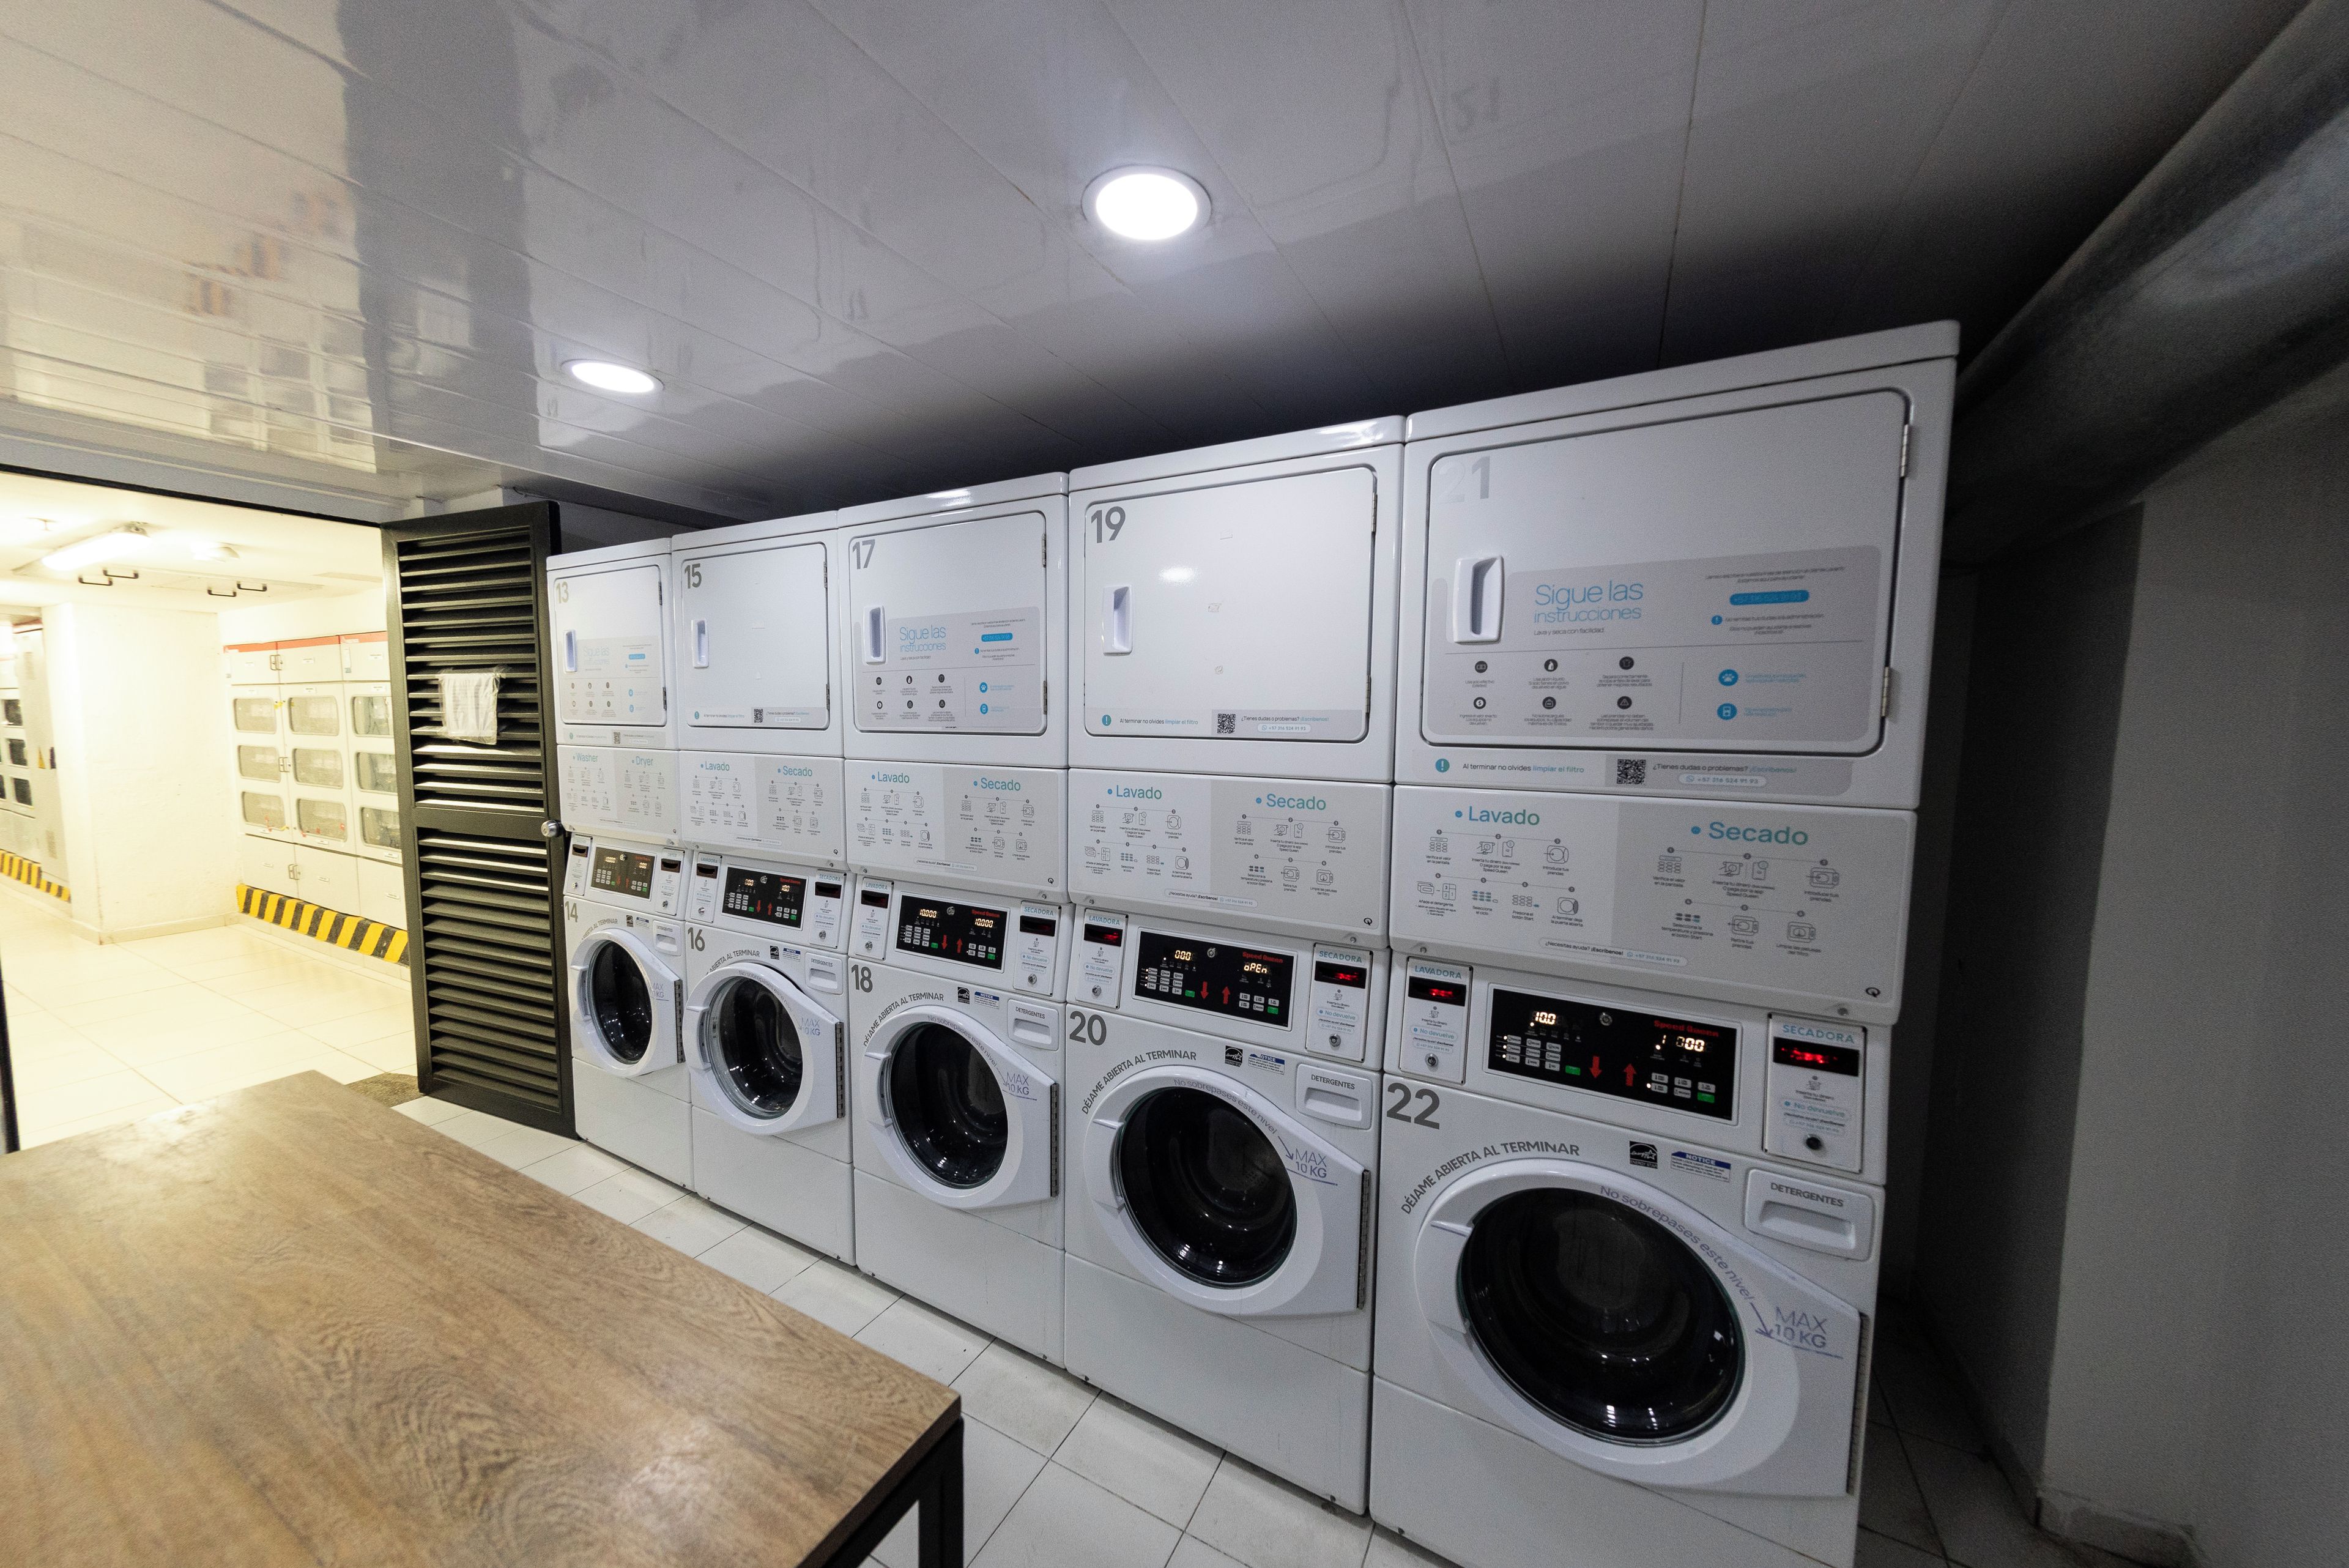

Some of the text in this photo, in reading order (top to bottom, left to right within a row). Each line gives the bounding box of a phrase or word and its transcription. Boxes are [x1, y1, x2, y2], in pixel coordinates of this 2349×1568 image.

[1438, 456, 1491, 503] 21
[1091, 506, 1126, 543] 19
[852, 538, 875, 570] 17
[684, 563, 702, 589] 15
[555, 581, 569, 603] 13
[1535, 580, 1644, 611] Sigue las
[1534, 607, 1642, 623] instrucciones
[899, 625, 946, 644] Sigue las
[900, 642, 946, 653] instrucciones
[576, 752, 598, 762] Washer
[636, 756, 653, 768] Dryer
[705, 761, 730, 771] Lavado
[782, 765, 813, 776] Secado
[877, 771, 910, 784] Lavado
[981, 778, 1021, 791] Secado
[1116, 784, 1162, 800] Lavado
[1266, 793, 1326, 810] Secado
[1469, 806, 1540, 825] Lavado
[1709, 822, 1809, 845] Secado
[565, 901, 578, 923] 14
[1024, 906, 1053, 916] SECADORA
[1089, 915, 1120, 926] LAVADORA
[688, 927, 705, 952] 16
[1319, 951, 1362, 963] SECADORA
[852, 964, 873, 993] 18
[1415, 965, 1462, 979] LAVADORA
[879, 1001, 900, 1023] ABIERTA
[908, 992, 944, 1001] TERMINAR
[1015, 1006, 1045, 1019] DETERGENTES
[1332, 1011, 1356, 1020] devuelve
[1069, 1011, 1107, 1046] 20
[1429, 1030, 1454, 1039] devuelve
[1653, 1020, 1685, 1031] Speed
[1783, 1024, 1855, 1044] SECADORA
[937, 1016, 971, 1039] sobrepases
[971, 1038, 984, 1051] este
[984, 1050, 997, 1067] nivel
[1006, 1072, 1029, 1087] MAX
[1082, 1050, 1197, 1115] DÉJAME ABIERTA AL TERMINAR
[1311, 1073, 1356, 1090] DETERGENTES
[1189, 1080, 1237, 1103] sobrepases
[1238, 1098, 1257, 1115] este
[1256, 1114, 1277, 1134] nivel
[1386, 1082, 1440, 1129] 22
[1295, 1148, 1327, 1167] MAX
[1686, 1153, 1716, 1165] NOTICE
[1296, 1161, 1327, 1178] 10 KG
[1401, 1140, 1580, 1214] DÉJAME ABIERTA AL TERMINAR
[1770, 1183, 1844, 1207] DETERGENTES
[1600, 1185, 1756, 1301] No sobrepases este nivel
[1775, 1306, 1827, 1334] MAX
[1775, 1324, 1827, 1349] 10 KG
